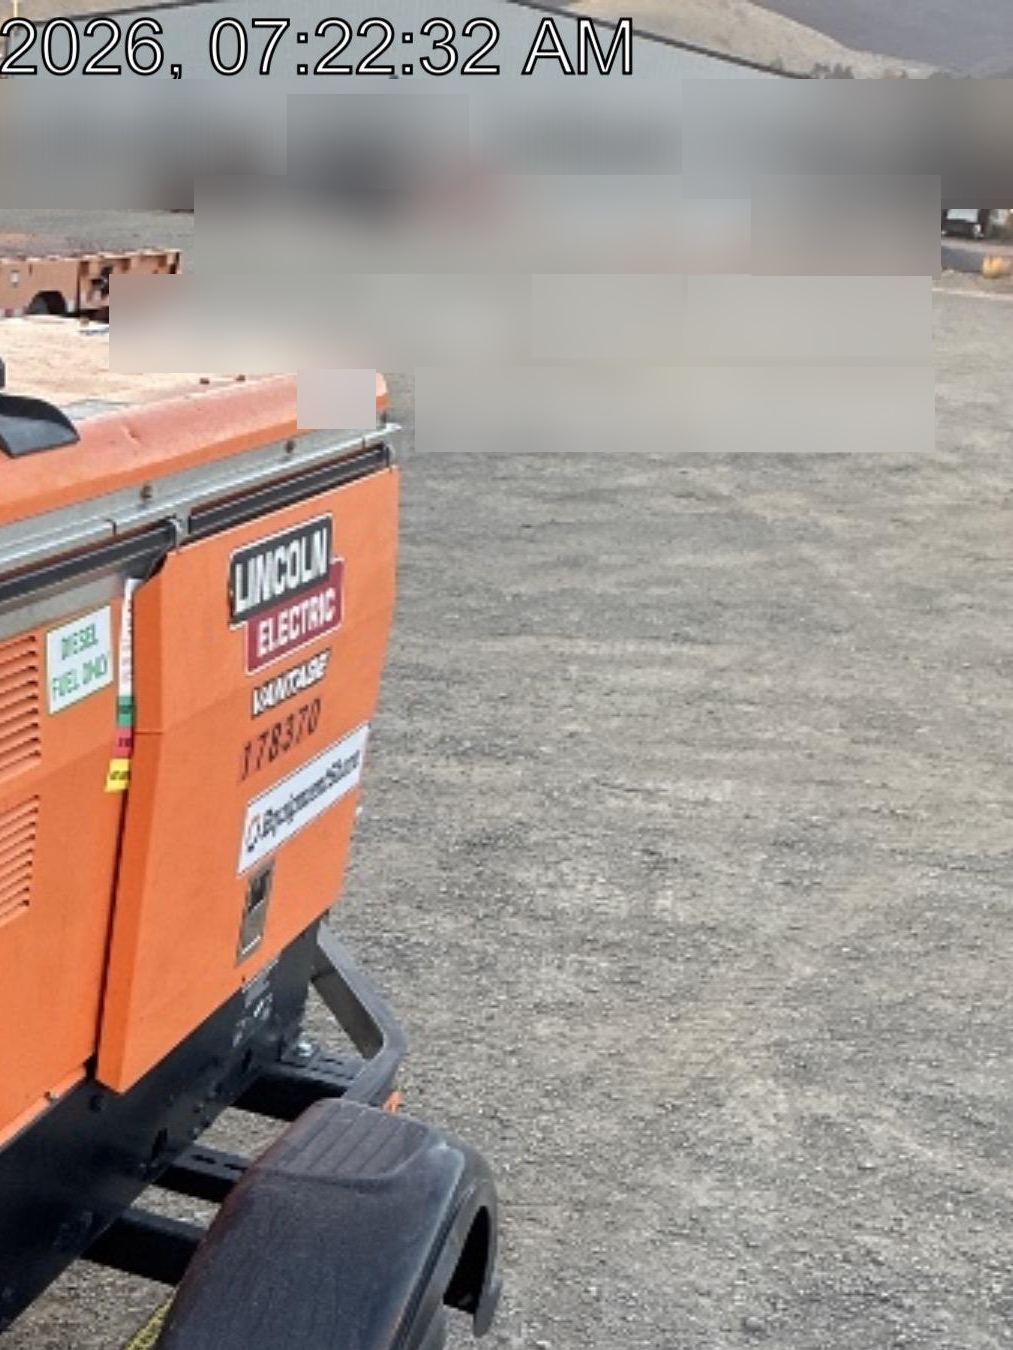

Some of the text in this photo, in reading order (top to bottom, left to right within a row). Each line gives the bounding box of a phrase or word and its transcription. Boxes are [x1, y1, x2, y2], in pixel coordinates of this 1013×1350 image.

[234, 527, 328, 614] LINCOLN
[256, 586, 337, 657] ELECTRIC
[240, 698, 322, 781] 178370
